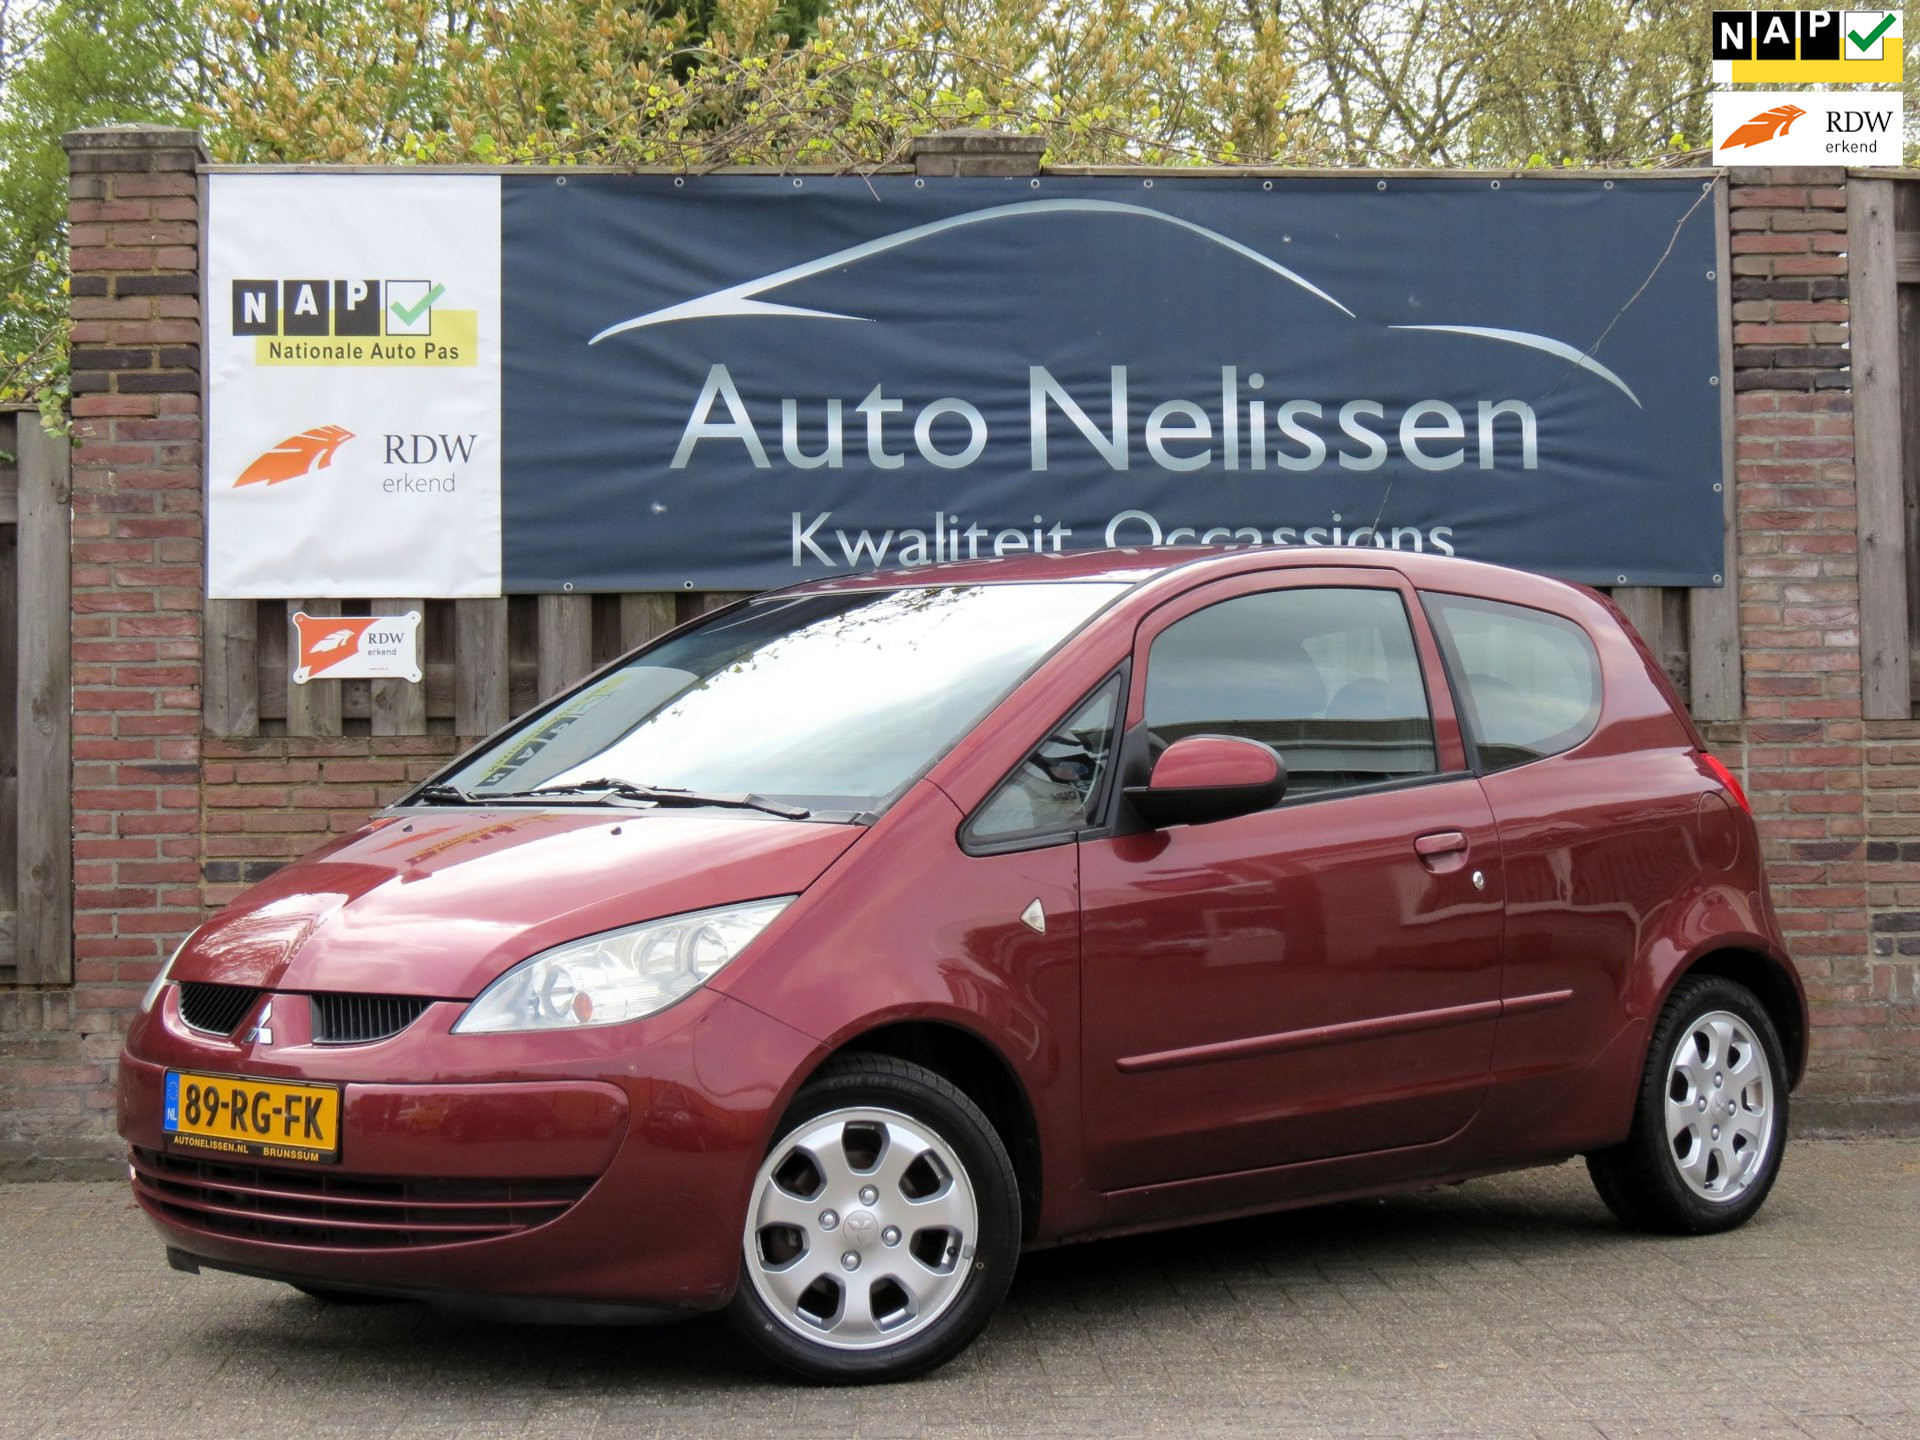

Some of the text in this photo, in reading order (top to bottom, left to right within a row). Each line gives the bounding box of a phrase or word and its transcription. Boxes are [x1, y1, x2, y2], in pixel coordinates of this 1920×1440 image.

[244, 280, 368, 324] NAP
[269, 341, 460, 361] Nationale Auto Pas
[669, 363, 1538, 472] Auto Nelissen
[383, 434, 478, 465] RDW
[382, 473, 456, 494] erkend
[792, 511, 1072, 567] Kwaliteit
[367, 632, 405, 644] RDW
[367, 648, 397, 656] erkend
[167, 1083, 324, 1140] NL 89-RG-FK
[173, 1135, 319, 1162] AUTONELISSEN.NL BRUNSSUM
